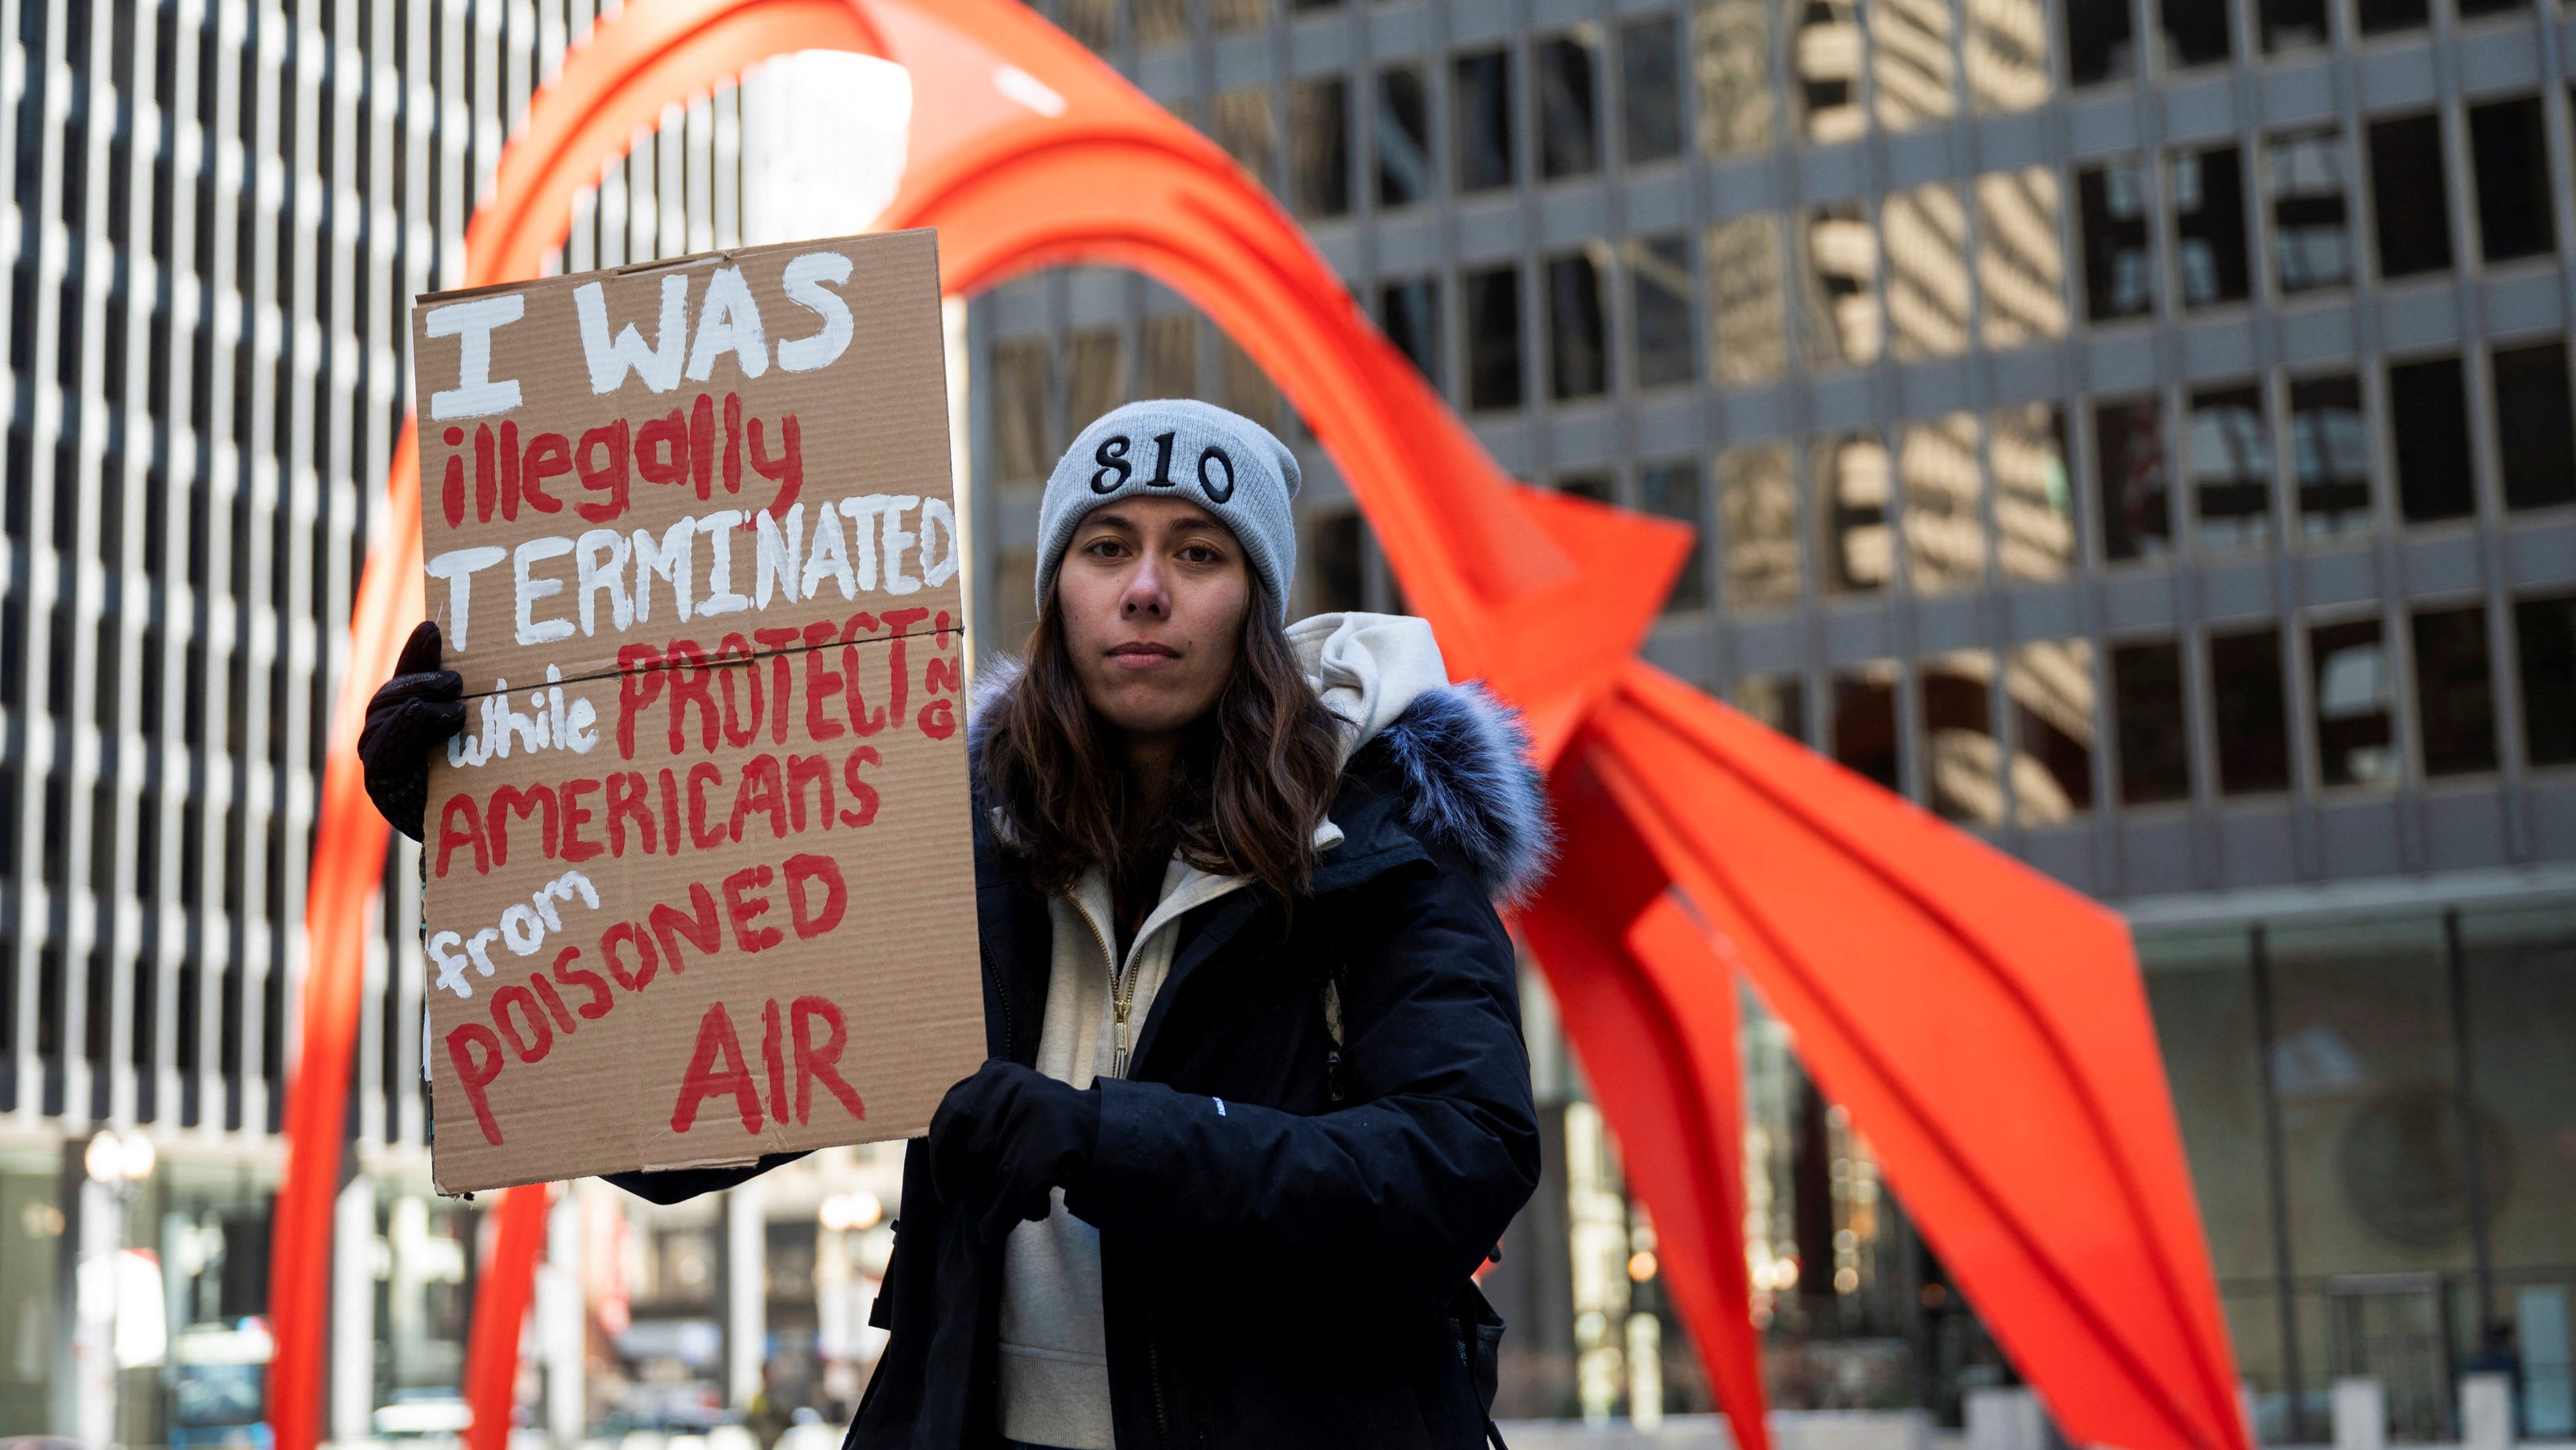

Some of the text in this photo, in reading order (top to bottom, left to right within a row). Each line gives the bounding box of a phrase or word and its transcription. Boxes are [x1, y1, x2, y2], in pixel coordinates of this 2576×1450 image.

[425, 252, 855, 420] I WAS
[442, 392, 804, 531] illegally
[1090, 431, 1235, 505] 810
[424, 494, 958, 652] TERMINATED
[448, 663, 600, 768] while
[429, 870, 601, 999] from
[445, 853, 848, 1146] POISONED
[671, 995, 866, 1135] AIR
